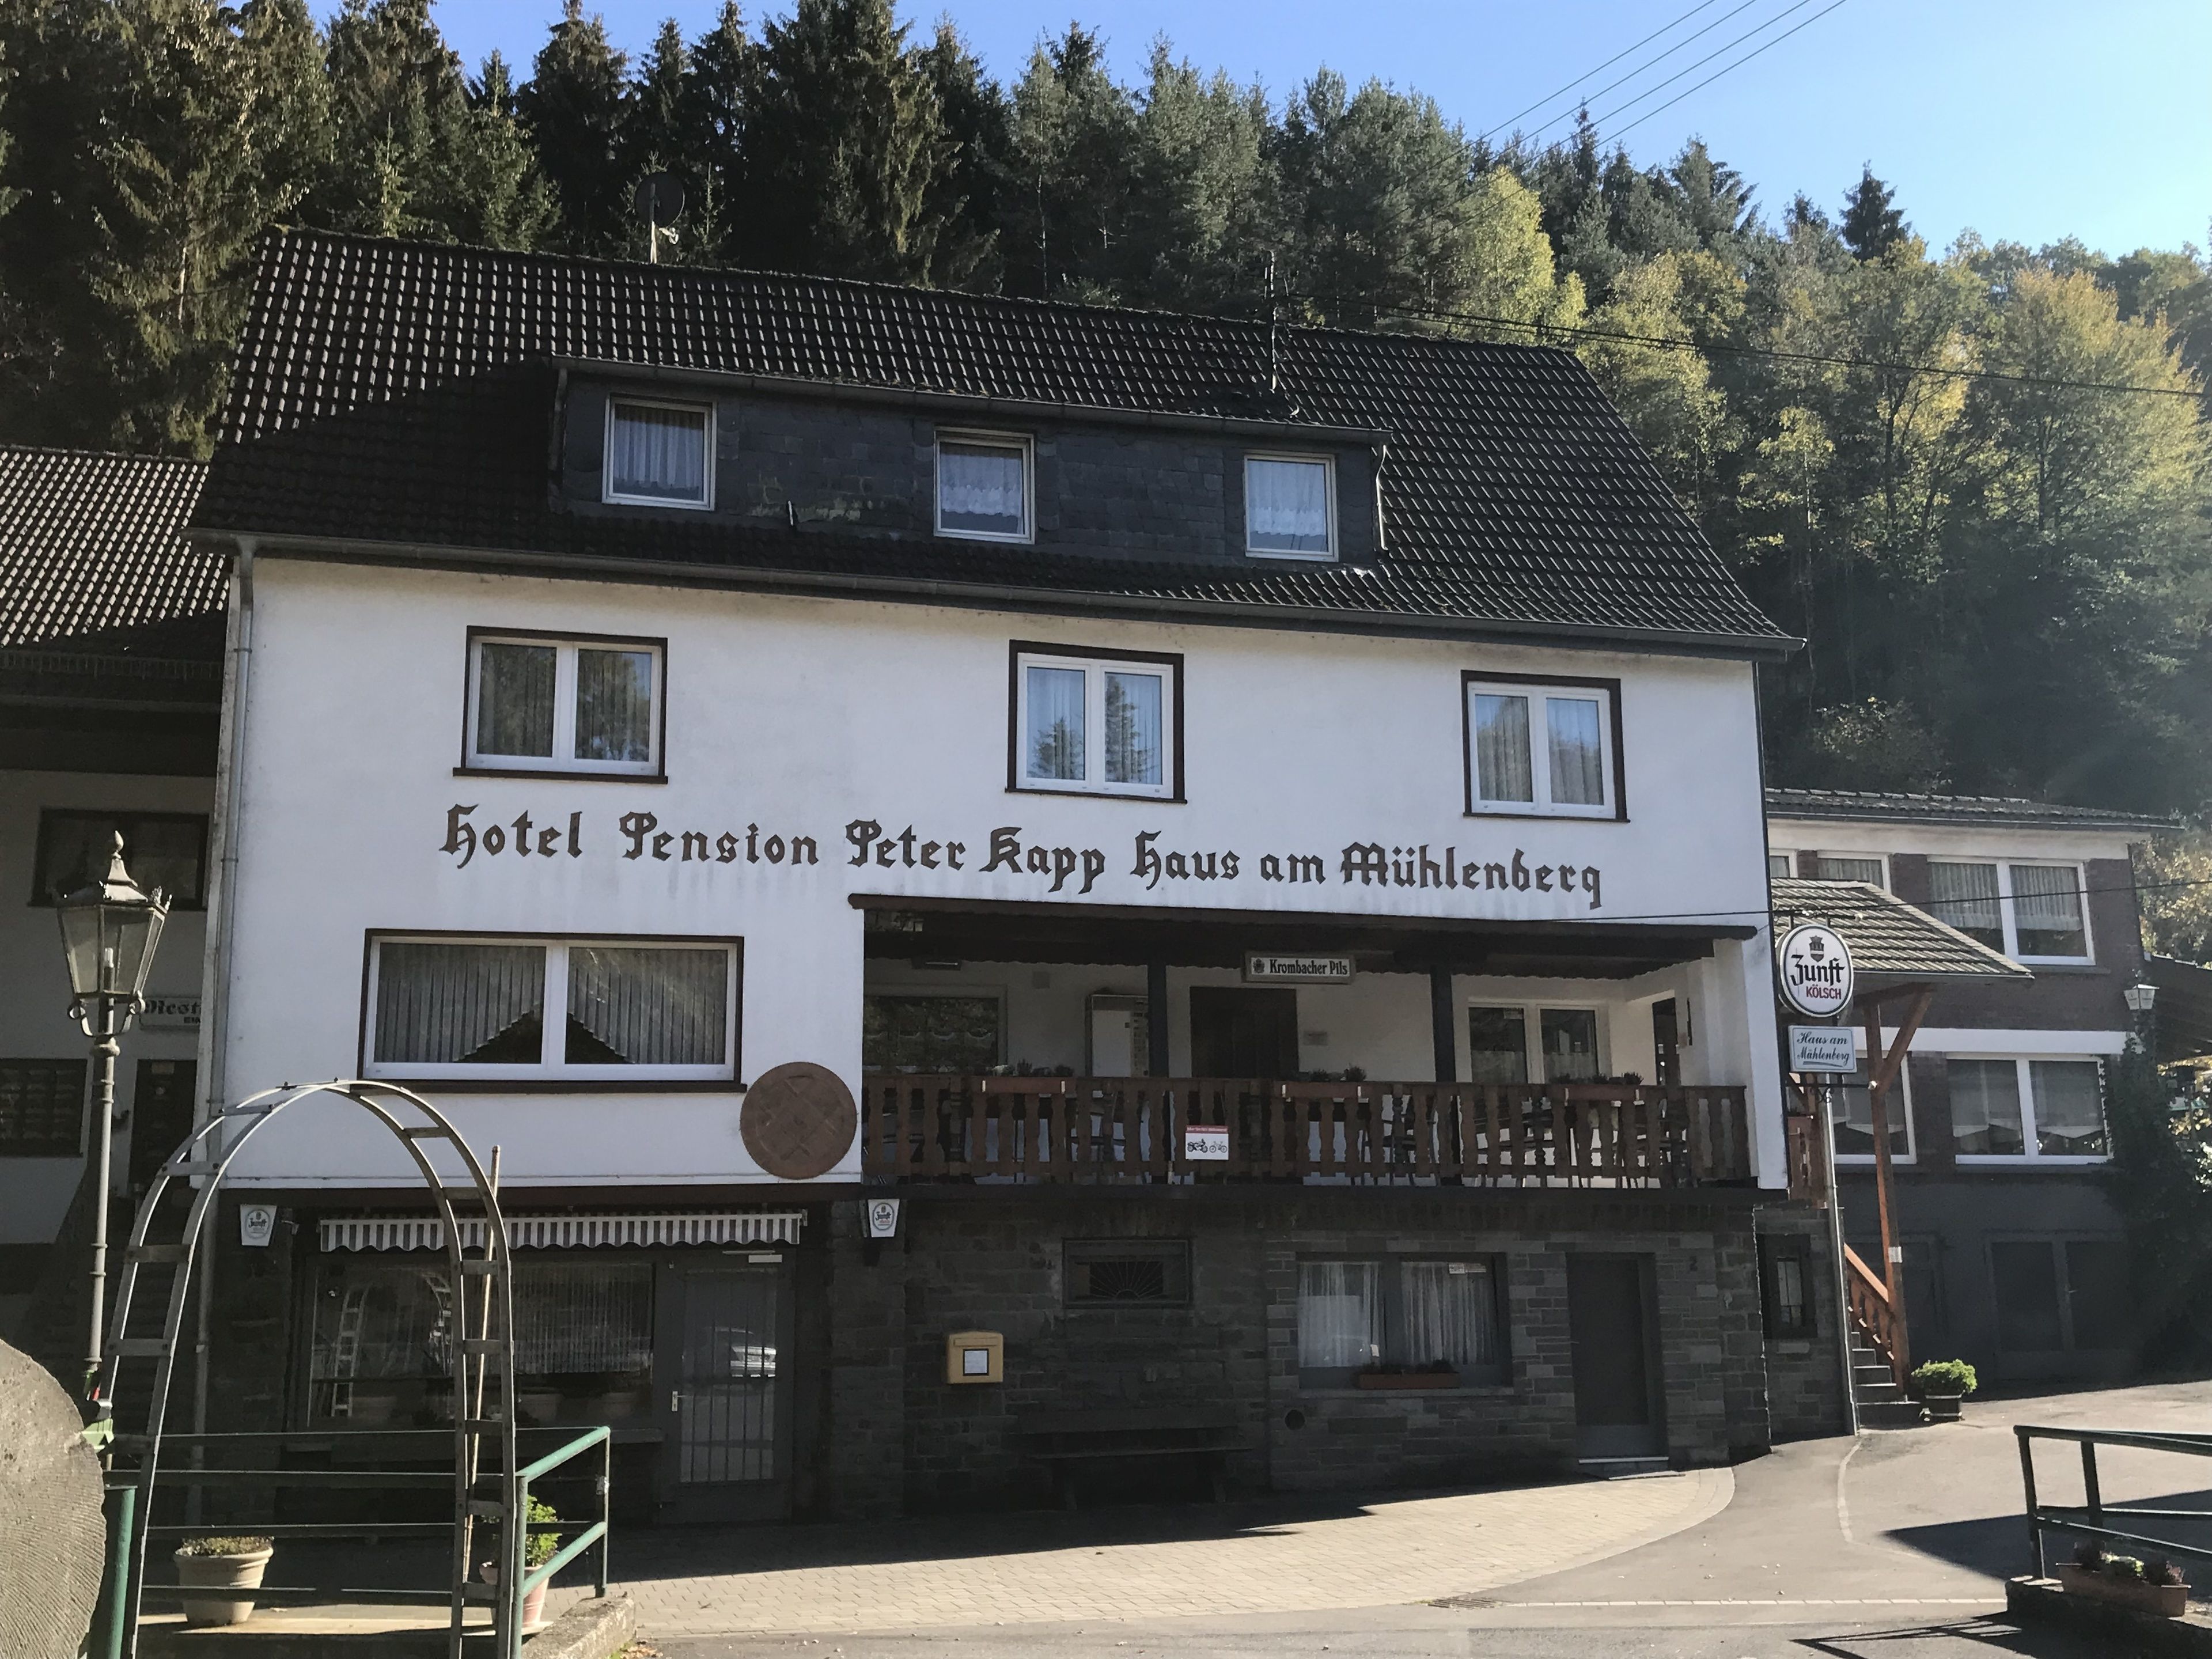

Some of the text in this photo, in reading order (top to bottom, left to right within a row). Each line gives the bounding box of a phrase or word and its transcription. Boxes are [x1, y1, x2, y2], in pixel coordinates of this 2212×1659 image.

[439, 804, 1602, 910] Hotel Pension Peter Kapp Haus am Mühlenberg
[1269, 959, 1348, 975] Krombacher Pils
[1790, 953, 1845, 987] Zunft
[1806, 984, 1842, 999] KÖLSCH
[1797, 1031, 1848, 1044] Haus am
